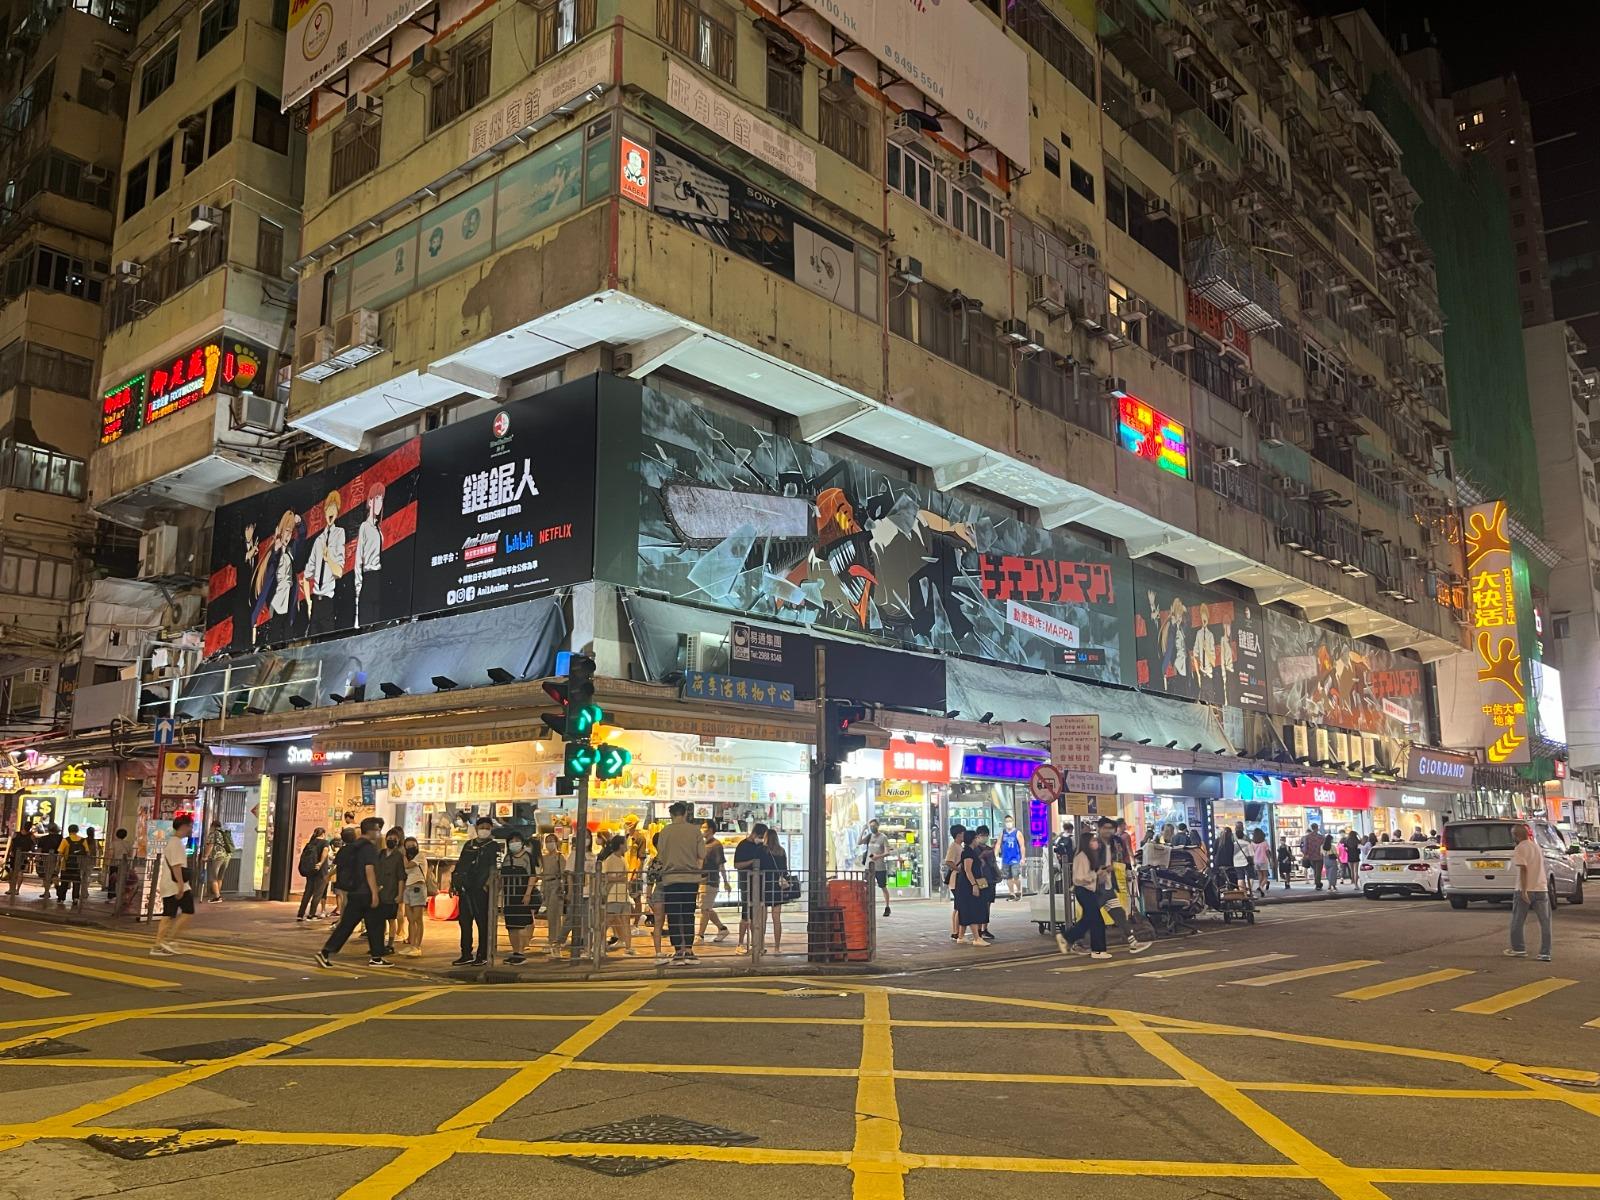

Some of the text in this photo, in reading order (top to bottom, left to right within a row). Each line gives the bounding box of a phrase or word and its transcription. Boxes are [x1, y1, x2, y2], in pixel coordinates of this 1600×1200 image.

[893, 51, 944, 99] 9495 5504
[472, 87, 541, 153] 廣州賓館
[671, 74, 751, 149] 旺角賓館
[747, 187, 779, 209] SONY
[462, 458, 540, 515] 鏈鋸人
[505, 531, 533, 553] bilibili
[539, 523, 572, 544] NETFLIX
[1471, 571, 1504, 627] 大快活
[1502, 568, 1516, 624] Fairwood
[691, 673, 792, 704] 荷李活購物中心
[1482, 703, 1524, 715] 中信大廈
[1493, 715, 1515, 726] 地庫
[1419, 756, 1464, 778] GIORDANO
[185, 786, 196, 794] 12
[886, 788, 910, 796] Nikon
[1314, 787, 1336, 803] Baleno
